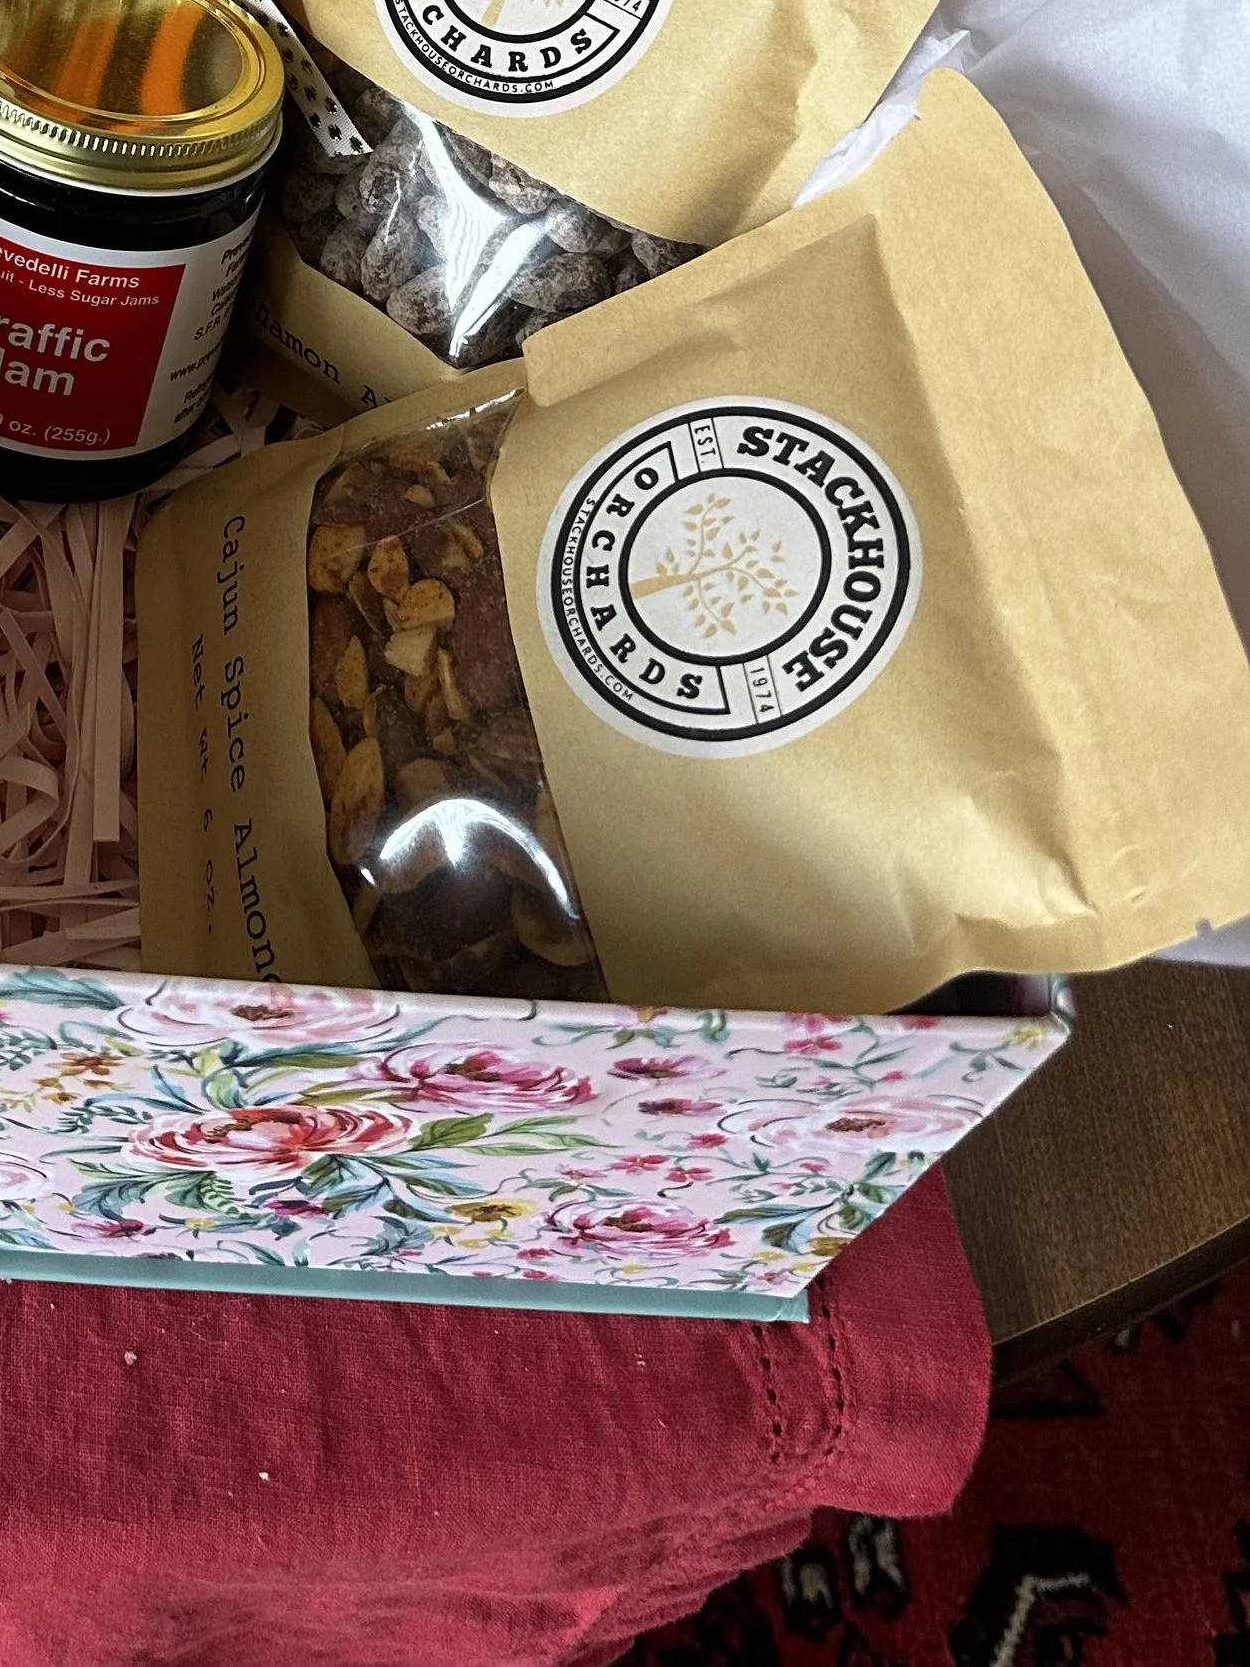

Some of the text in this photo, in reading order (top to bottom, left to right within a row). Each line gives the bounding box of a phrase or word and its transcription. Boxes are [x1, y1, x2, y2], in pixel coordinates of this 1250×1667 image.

[27, 278, 65, 299] Less
[69, 287, 118, 309] Sugar
[120, 293, 160, 307] Jams
[74, 269, 141, 289] Farms
[8, 419, 37, 437] oz.
[43, 425, 112, 446] (255g.)
[693, 424, 717, 465] EST.
[216, 514, 247, 637] Cajun
[586, 466, 703, 700] ORCHARDS
[737, 425, 885, 693] STACKHOUSE
[562, 497, 635, 702] STACKHOUSEORCHARDS.COM
[192, 634, 206, 712] Net
[749, 666, 776, 715] 1974
[220, 655, 253, 794] Spice
[202, 808, 214, 833] 6
[205, 859, 218, 935] oz.
